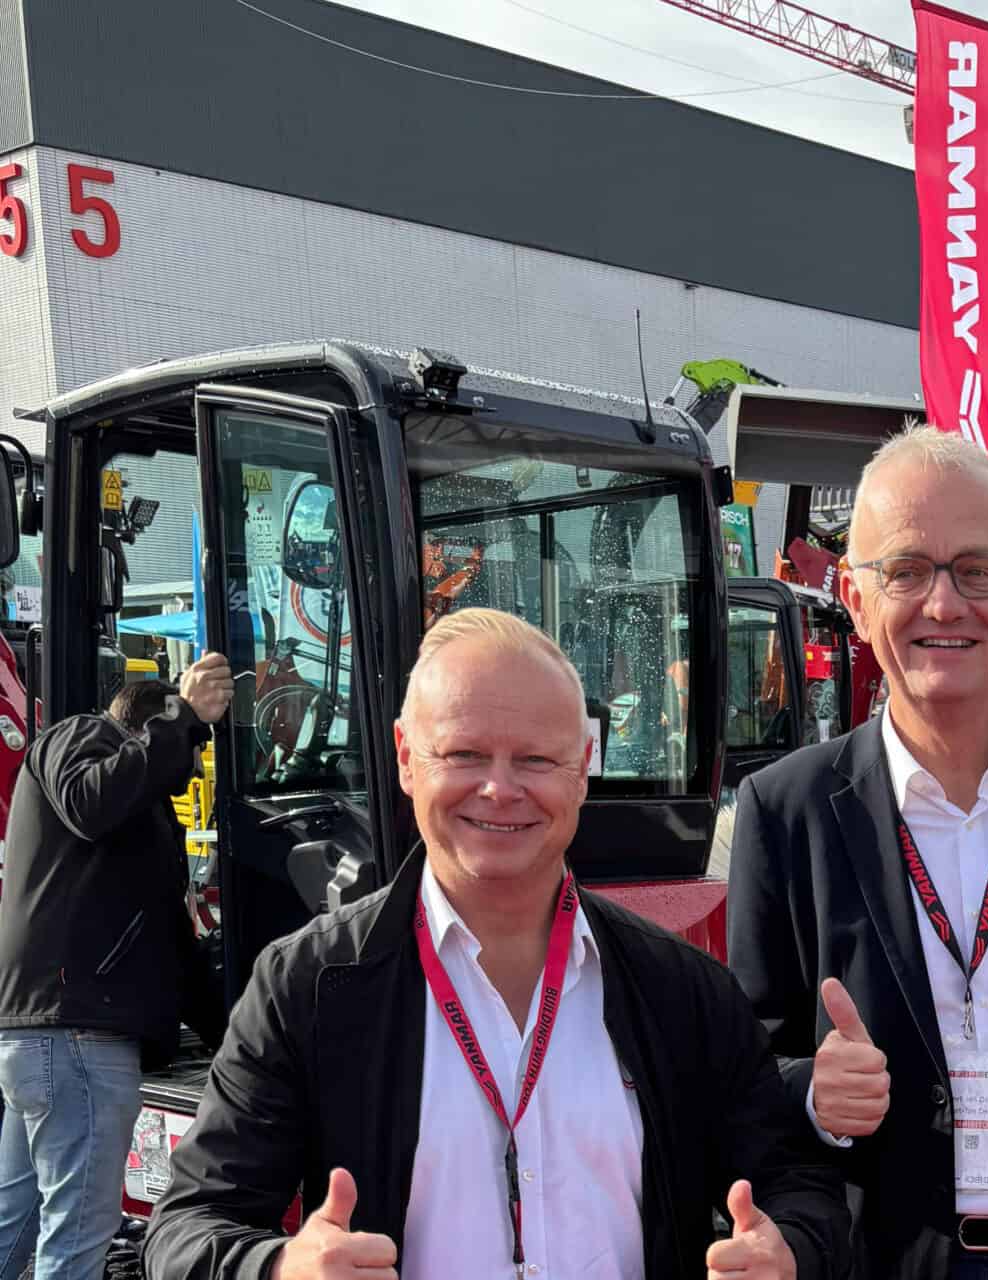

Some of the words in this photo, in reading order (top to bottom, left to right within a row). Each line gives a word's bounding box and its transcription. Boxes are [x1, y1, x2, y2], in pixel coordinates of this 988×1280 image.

[67, 163, 121, 258] 5
[444, 1001, 488, 1077] YANMAR
[538, 987, 558, 1045] BUILDING
